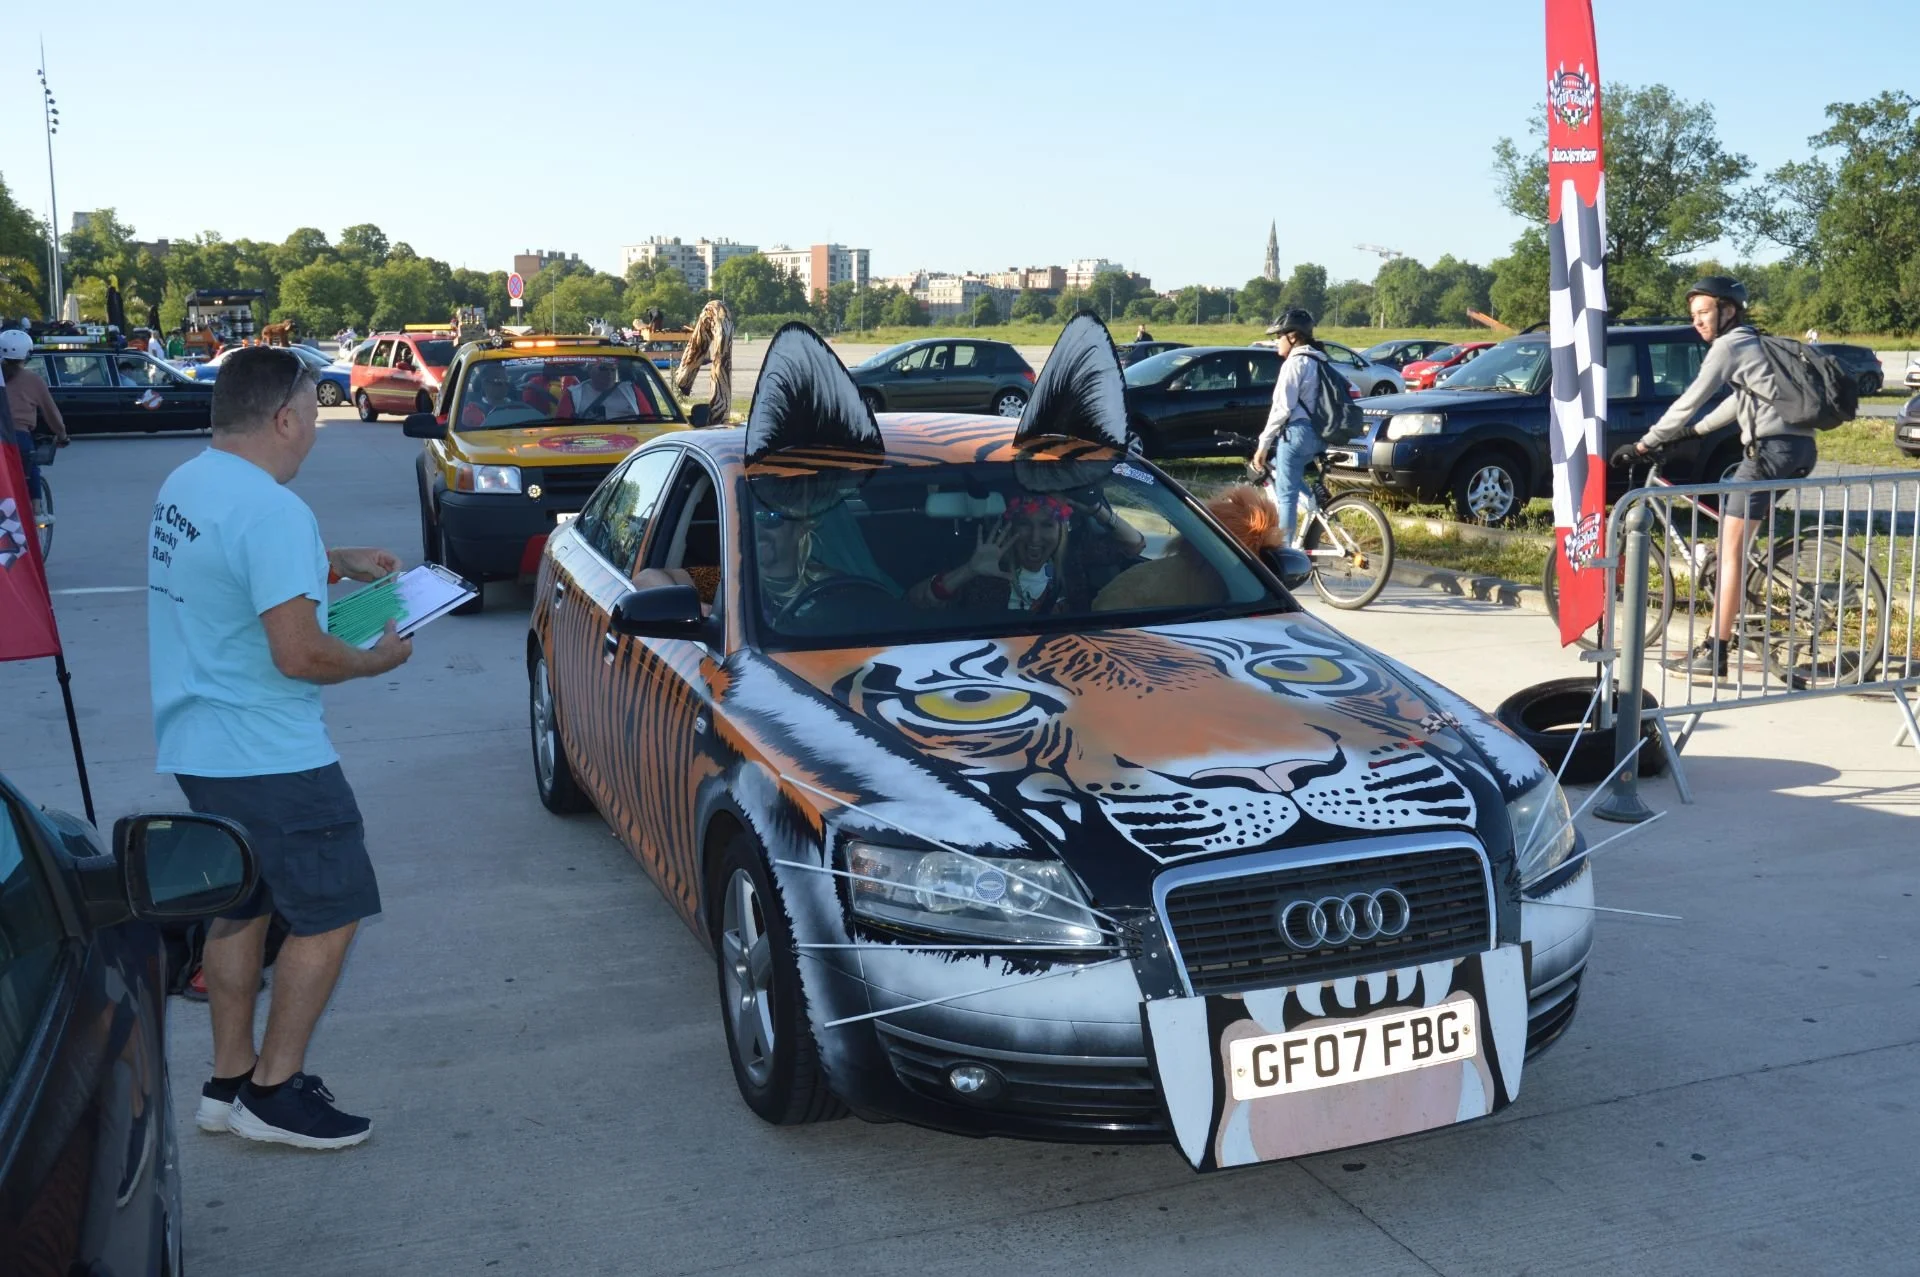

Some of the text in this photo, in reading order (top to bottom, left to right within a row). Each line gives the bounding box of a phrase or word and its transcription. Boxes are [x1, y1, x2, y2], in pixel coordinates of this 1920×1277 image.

[154, 526, 179, 550] Wacky
[166, 503, 201, 543] Crew
[1252, 1011, 1460, 1088] GF07 FBG
